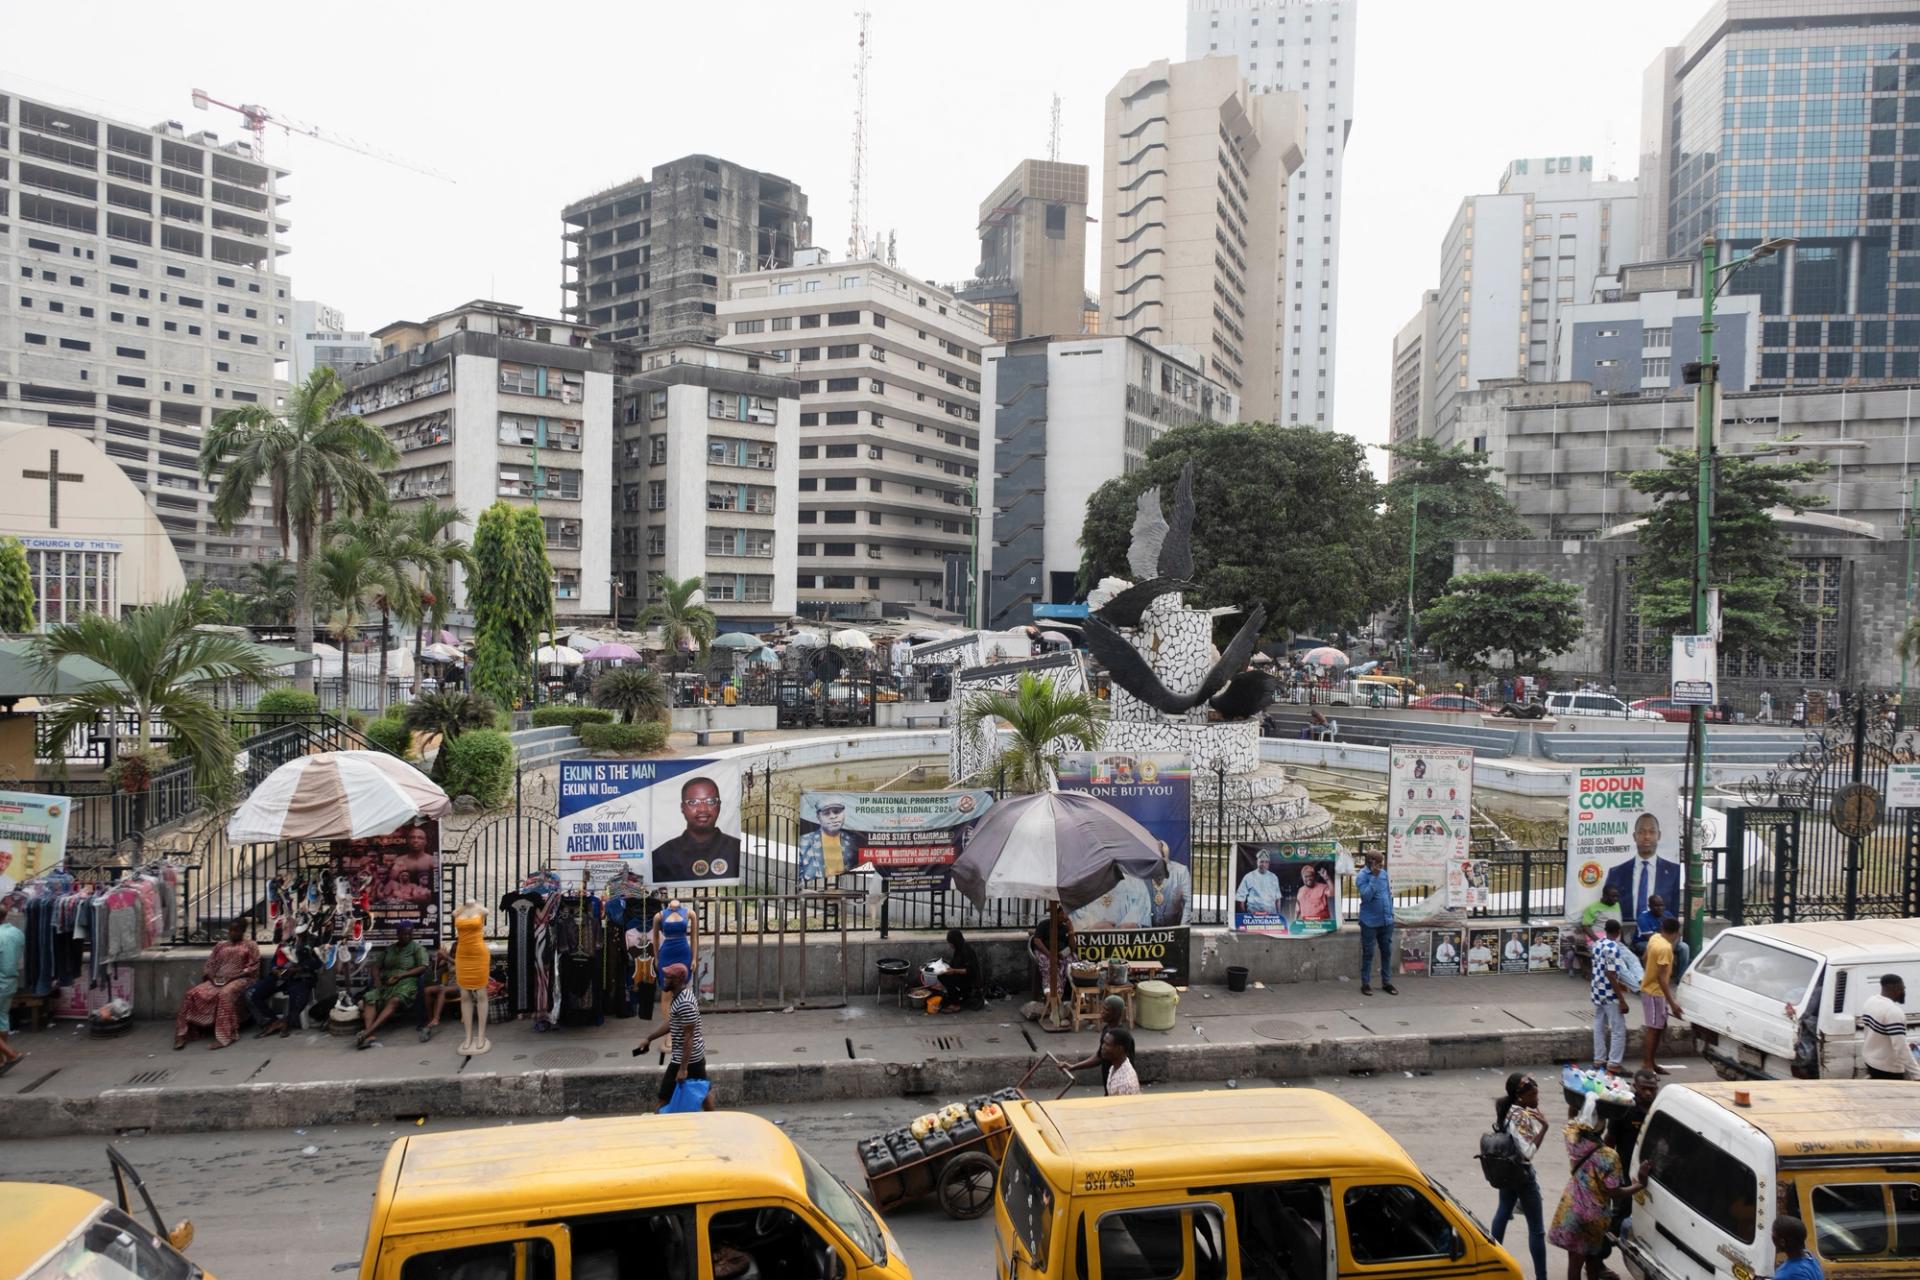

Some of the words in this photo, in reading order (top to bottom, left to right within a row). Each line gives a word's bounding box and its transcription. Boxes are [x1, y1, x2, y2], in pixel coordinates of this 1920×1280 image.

[33, 540, 70, 548] CHURCH
[563, 765, 592, 781] EKUN
[595, 765, 606, 780] IS
[609, 764, 629, 780] THE
[632, 763, 656, 779] MAN
[563, 783, 587, 796] EKUN
[589, 783, 599, 794] NI
[1580, 777, 1644, 792] BIODUN
[1091, 787, 1118, 797] ONE
[1121, 787, 1146, 797] BUT
[1147, 786, 1173, 796] YOU
[872, 797, 907, 805] NATIONAL
[1579, 791, 1644, 810] COKER
[855, 806, 895, 814] PROGRESS
[573, 823, 596, 834] ENGR.
[598, 821, 637, 833] SULAIMAN
[1578, 822, 1628, 836] CHAIRMAN
[913, 832, 949, 840] CHAIRMAN
[1577, 838, 1594, 846] LAGOS
[1595, 837, 1614, 845] ISLAND
[566, 835, 608, 853] AREMU
[612, 833, 645, 850] EKUN
[1577, 846, 1593, 854] LOCAL
[1595, 845, 1630, 854] GOVERNMENT
[1089, 933, 1130, 945] MUIBI
[1133, 931, 1175, 944] ALADE
[1077, 944, 1166, 960] FOLAWIYO
